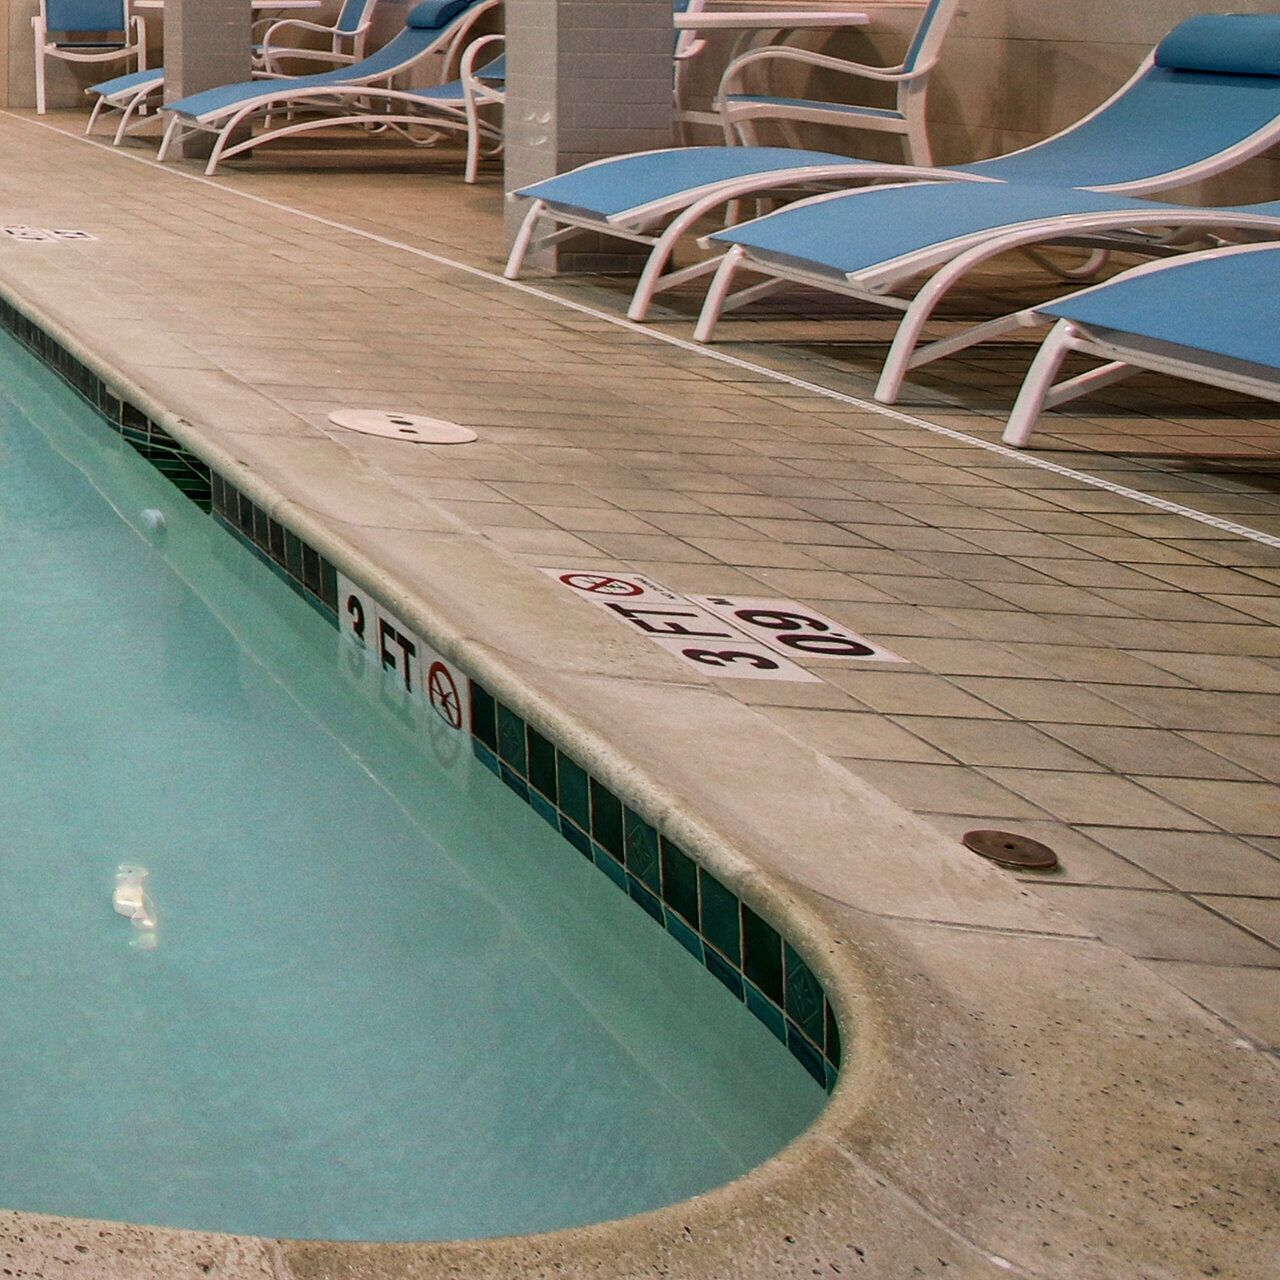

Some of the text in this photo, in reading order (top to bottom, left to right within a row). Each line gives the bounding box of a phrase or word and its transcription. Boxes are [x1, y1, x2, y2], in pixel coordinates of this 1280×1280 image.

[378, 617, 417, 694] FT
[603, 602, 780, 670] 3 FT
